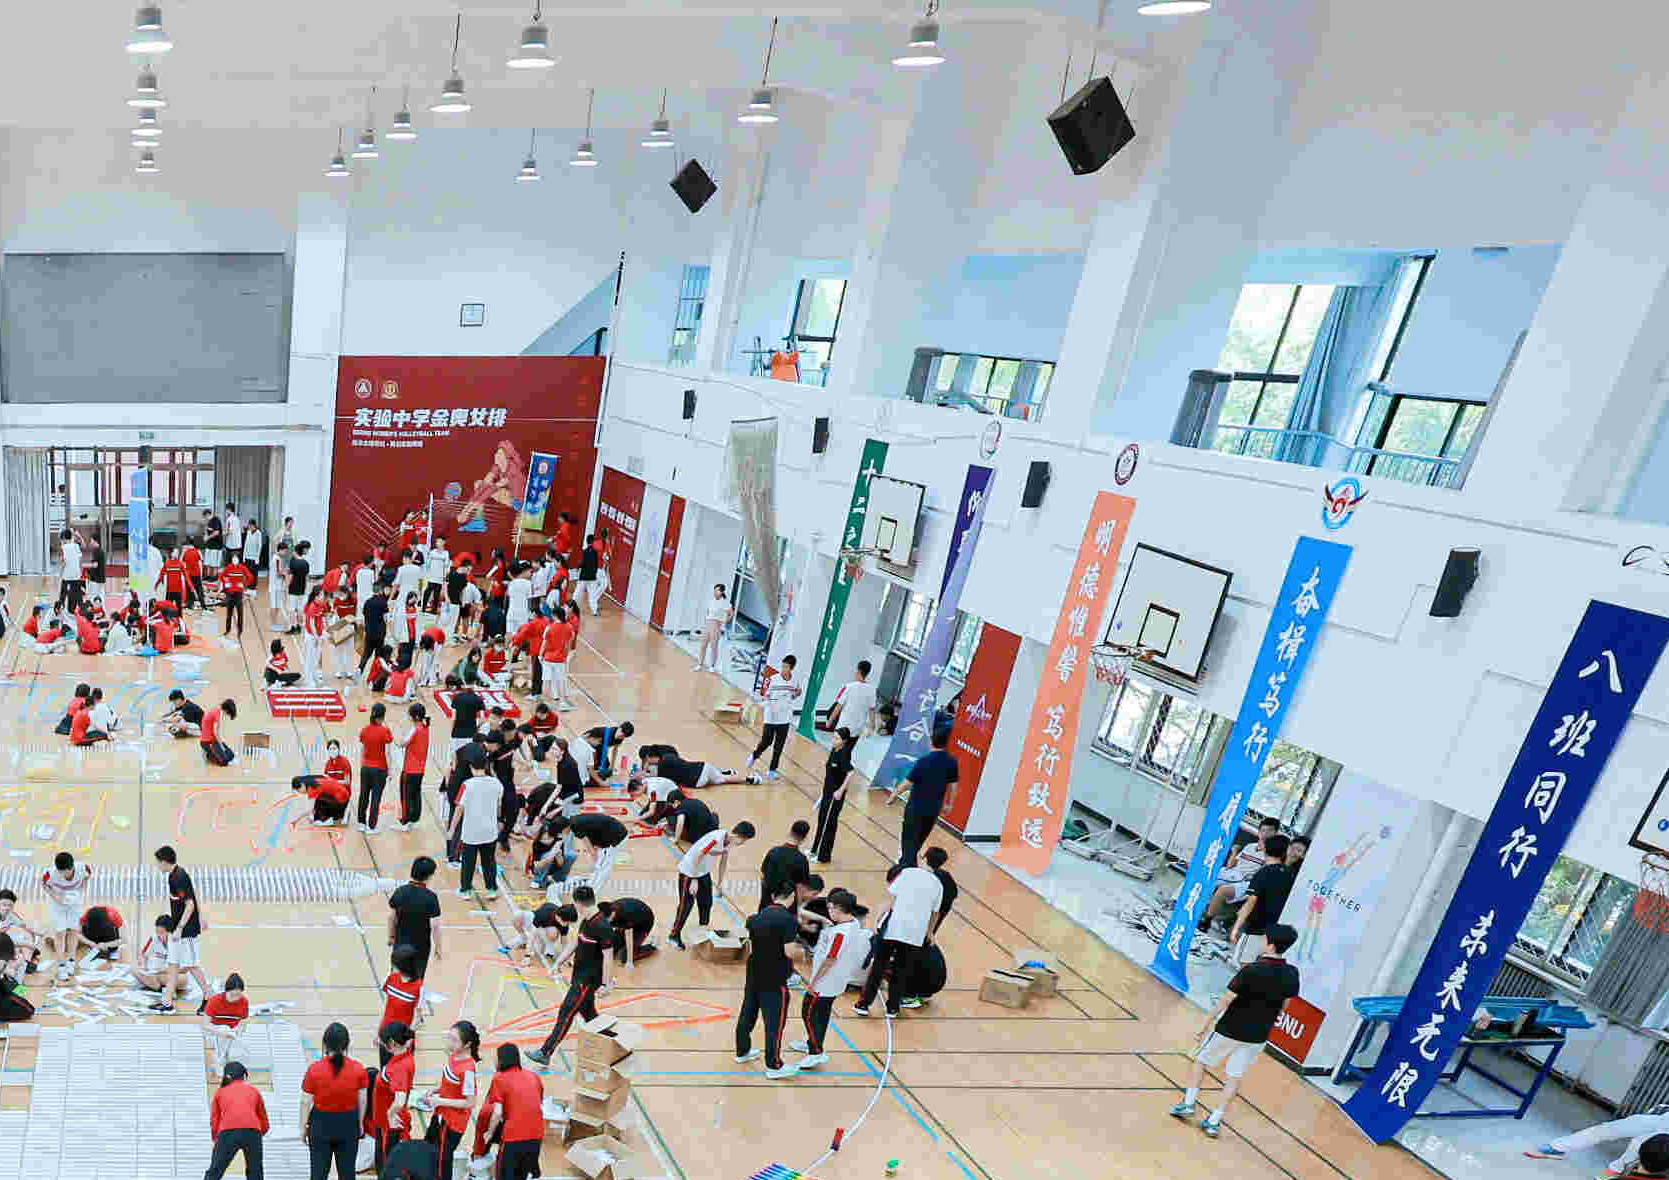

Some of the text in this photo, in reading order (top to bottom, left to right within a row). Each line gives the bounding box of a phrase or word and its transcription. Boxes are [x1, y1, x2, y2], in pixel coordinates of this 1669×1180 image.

[1498, 648, 1623, 880] 八班同行
[1307, 879, 1362, 913] TOGETHER
